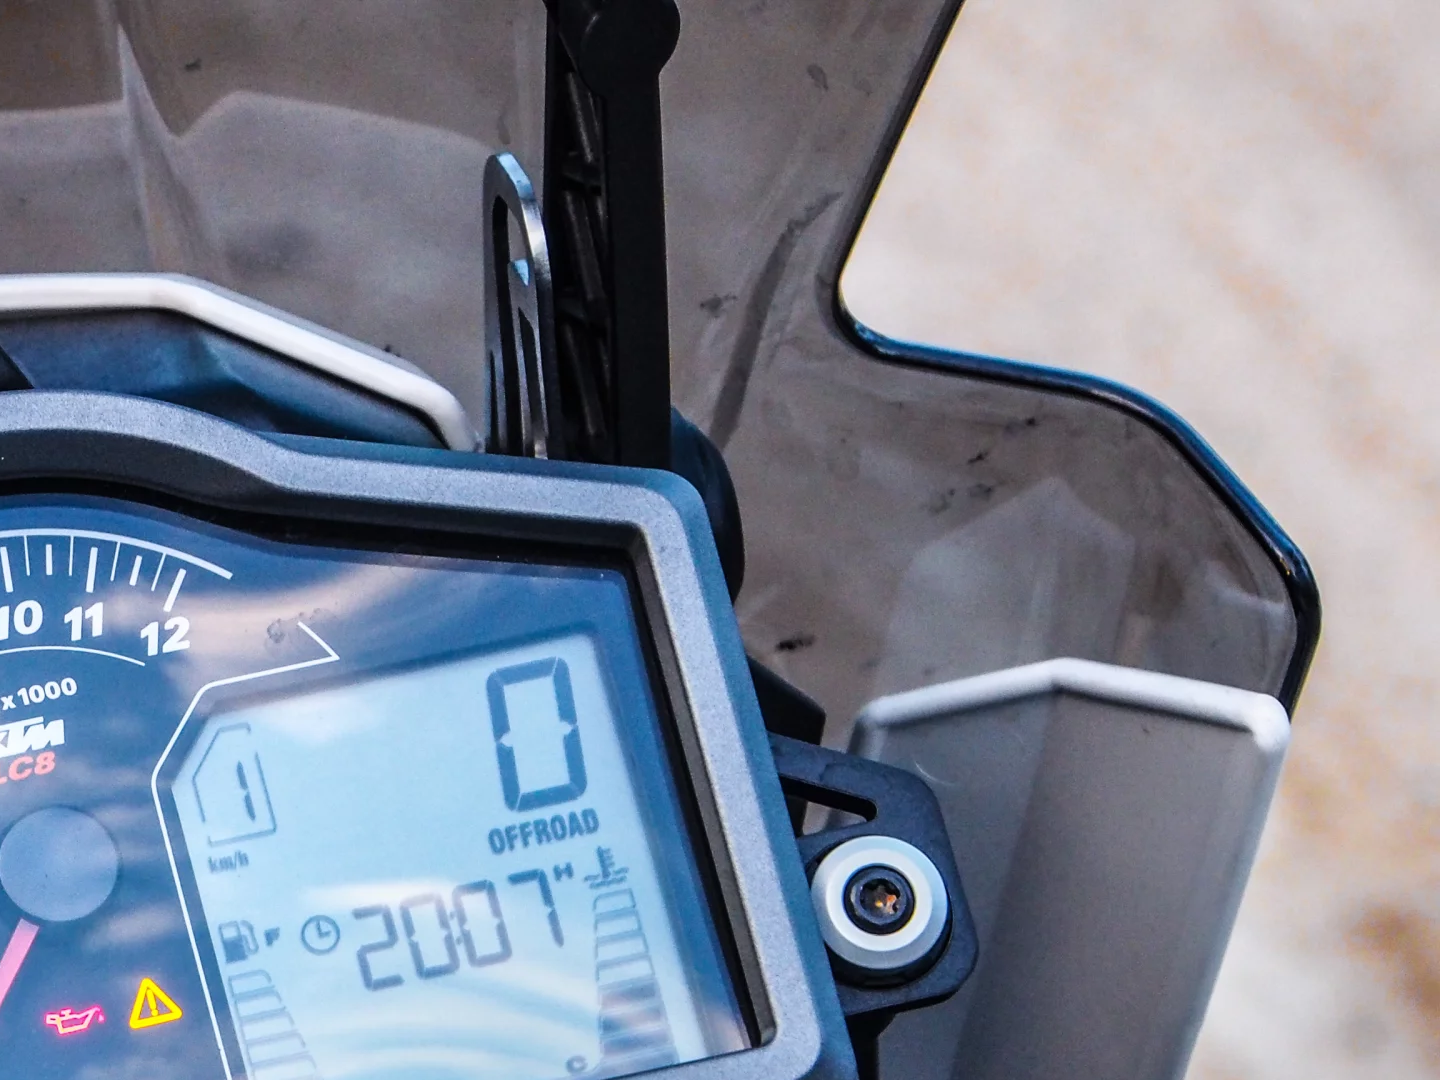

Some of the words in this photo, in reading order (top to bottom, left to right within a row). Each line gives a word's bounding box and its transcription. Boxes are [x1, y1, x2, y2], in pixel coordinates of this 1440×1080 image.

[64, 603, 105, 641] 11
[140, 617, 191, 656] 12
[0, 695, 16, 710] x
[17, 677, 78, 706] 1000
[486, 656, 587, 812] 0
[488, 808, 599, 855] OFFROAD
